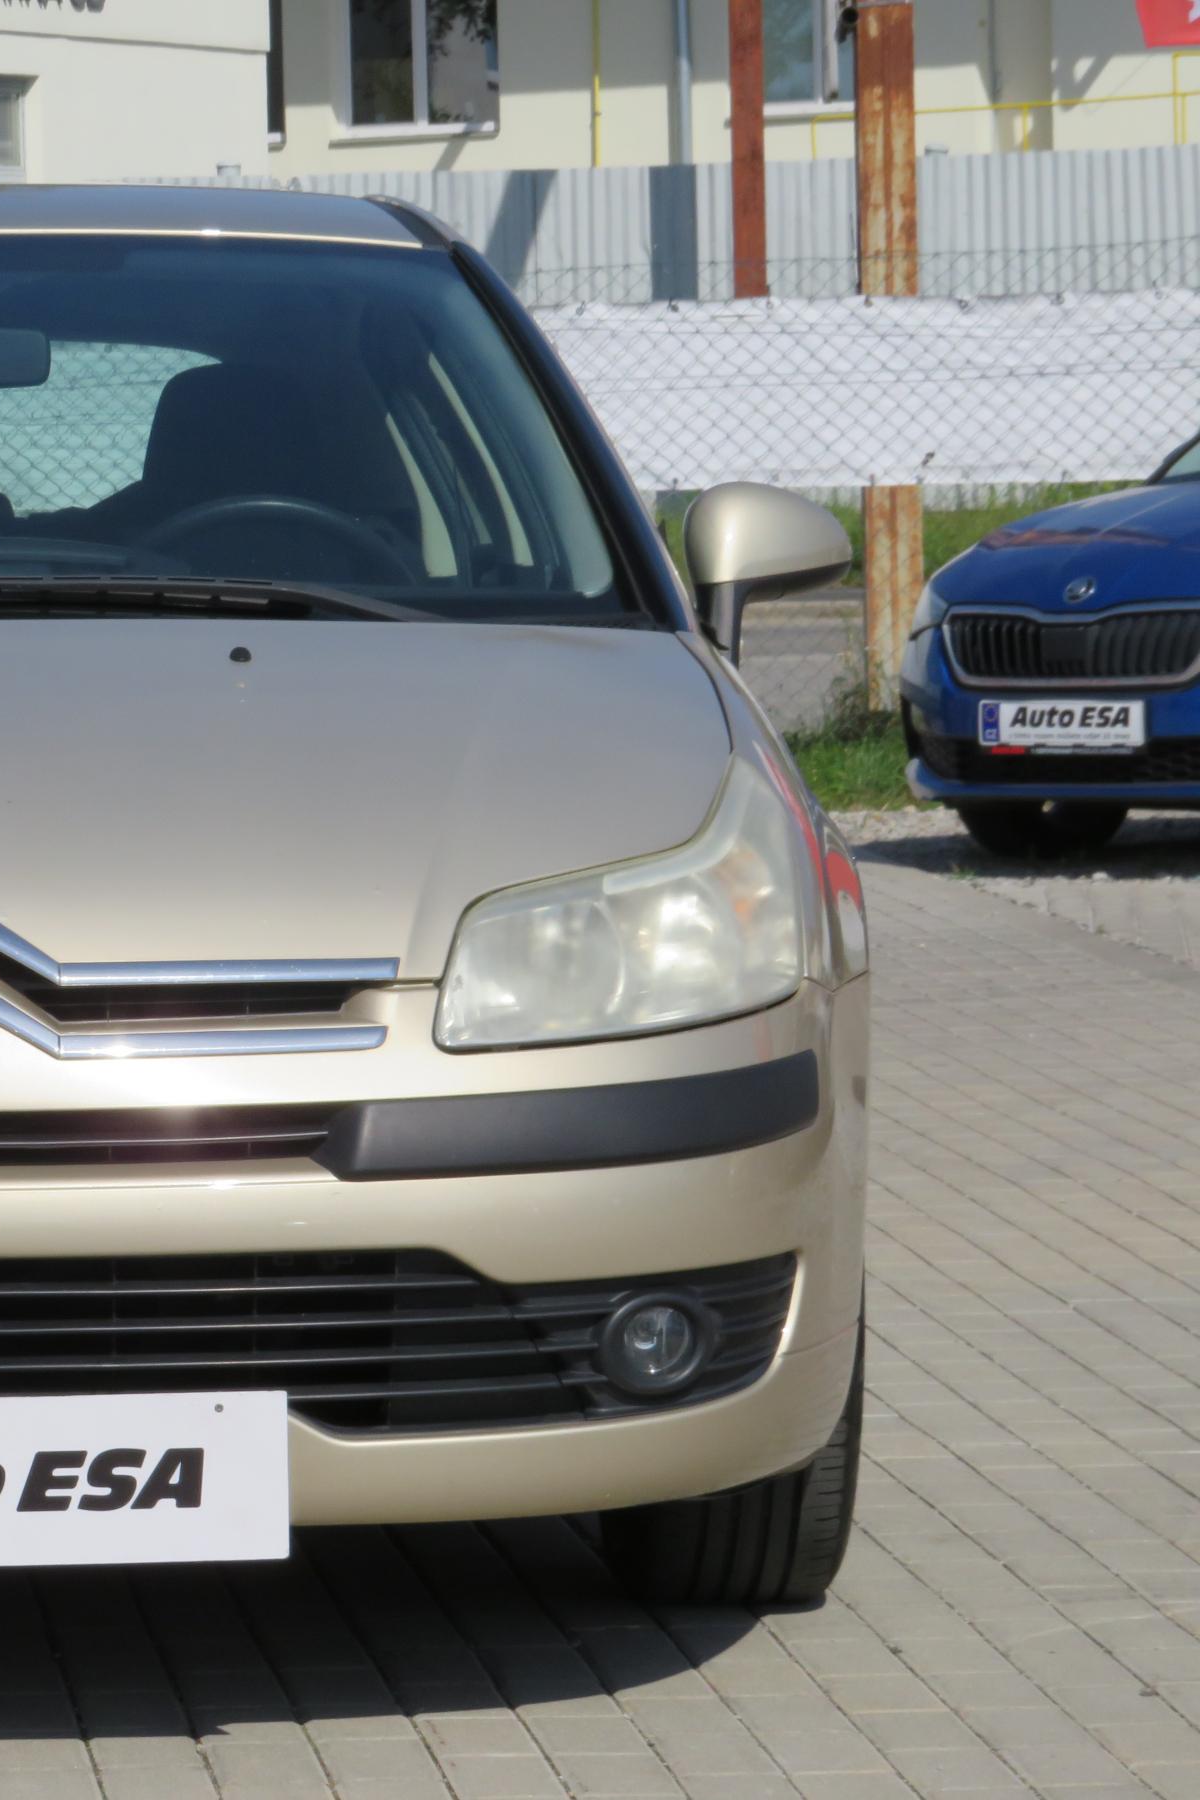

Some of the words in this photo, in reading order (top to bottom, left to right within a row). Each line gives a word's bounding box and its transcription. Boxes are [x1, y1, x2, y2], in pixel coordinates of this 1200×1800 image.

[1009, 706, 1074, 728] Auto
[1078, 706, 1130, 728] ESA
[16, 1447, 204, 1512] ESA
